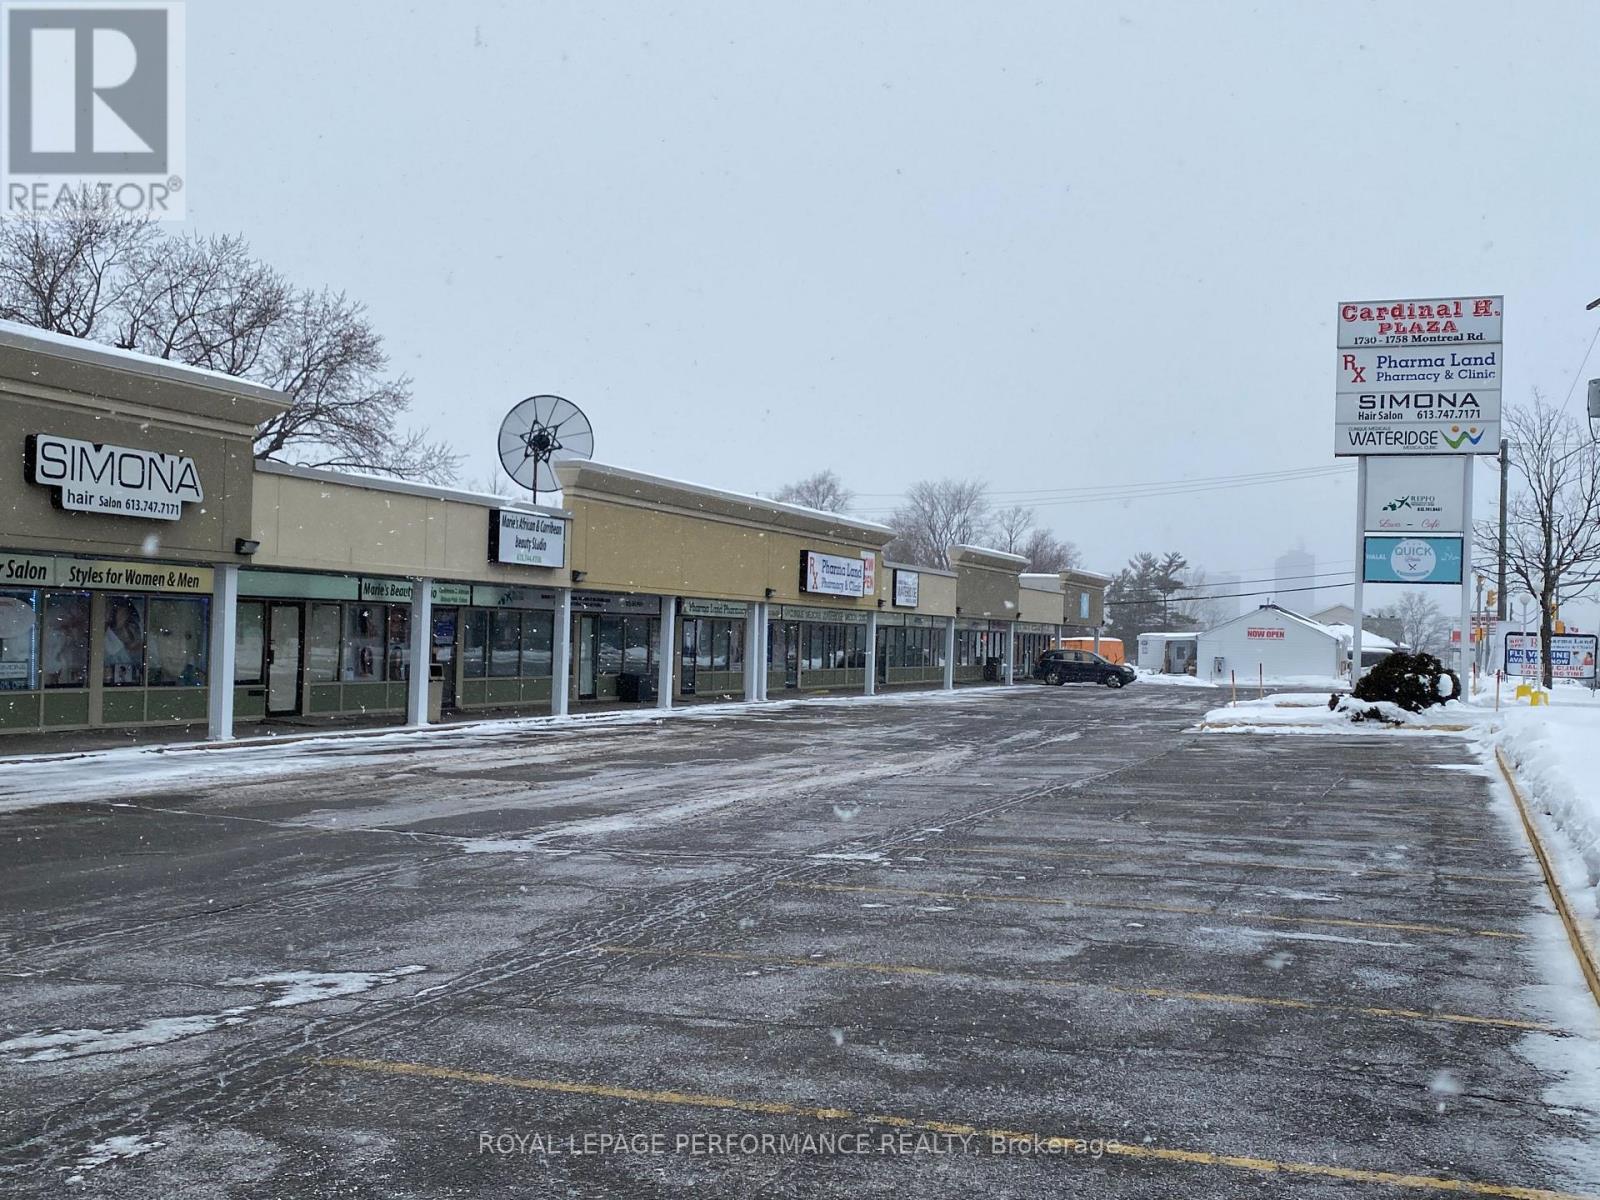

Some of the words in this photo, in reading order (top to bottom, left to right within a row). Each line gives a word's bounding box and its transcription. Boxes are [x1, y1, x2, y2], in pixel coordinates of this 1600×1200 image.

[1342, 301, 1463, 321] Cardinal
[1473, 299, 1501, 317] H.
[1378, 320, 1458, 335] PLAZA
[1354, 337, 1377, 345] 1730
[1386, 335, 1408, 344] 1758
[1411, 333, 1464, 343] Montreal
[1376, 355, 1446, 369] Pharma
[1451, 352, 1496, 367] Land
[1376, 371, 1440, 383] Pharmacy
[1444, 370, 1454, 380] &
[1458, 369, 1496, 379] Clinic
[1359, 392, 1480, 410] SIMONA
[1358, 411, 1377, 421] Hair
[1378, 411, 1403, 420] Salon
[1417, 409, 1481, 419] 613.747.7171
[1348, 430, 1438, 446] WATERIDGE
[40, 441, 200, 497] SIMONA
[67, 488, 95, 506] hair
[98, 495, 122, 509] Salon
[125, 498, 180, 515] 613.747.7171
[1394, 547, 1432, 556] QUICK
[6, 560, 47, 580] Salon
[821, 559, 846, 576] Pharma
[846, 563, 862, 578] Land
[69, 565, 102, 586] Styles
[106, 567, 123, 584] for
[125, 569, 165, 587] Women
[167, 571, 176, 587] &
[177, 572, 200, 589] Men
[363, 582, 389, 596] Marie's
[1248, 630, 1265, 638] NOW
[1266, 630, 1285, 638] OPEN
